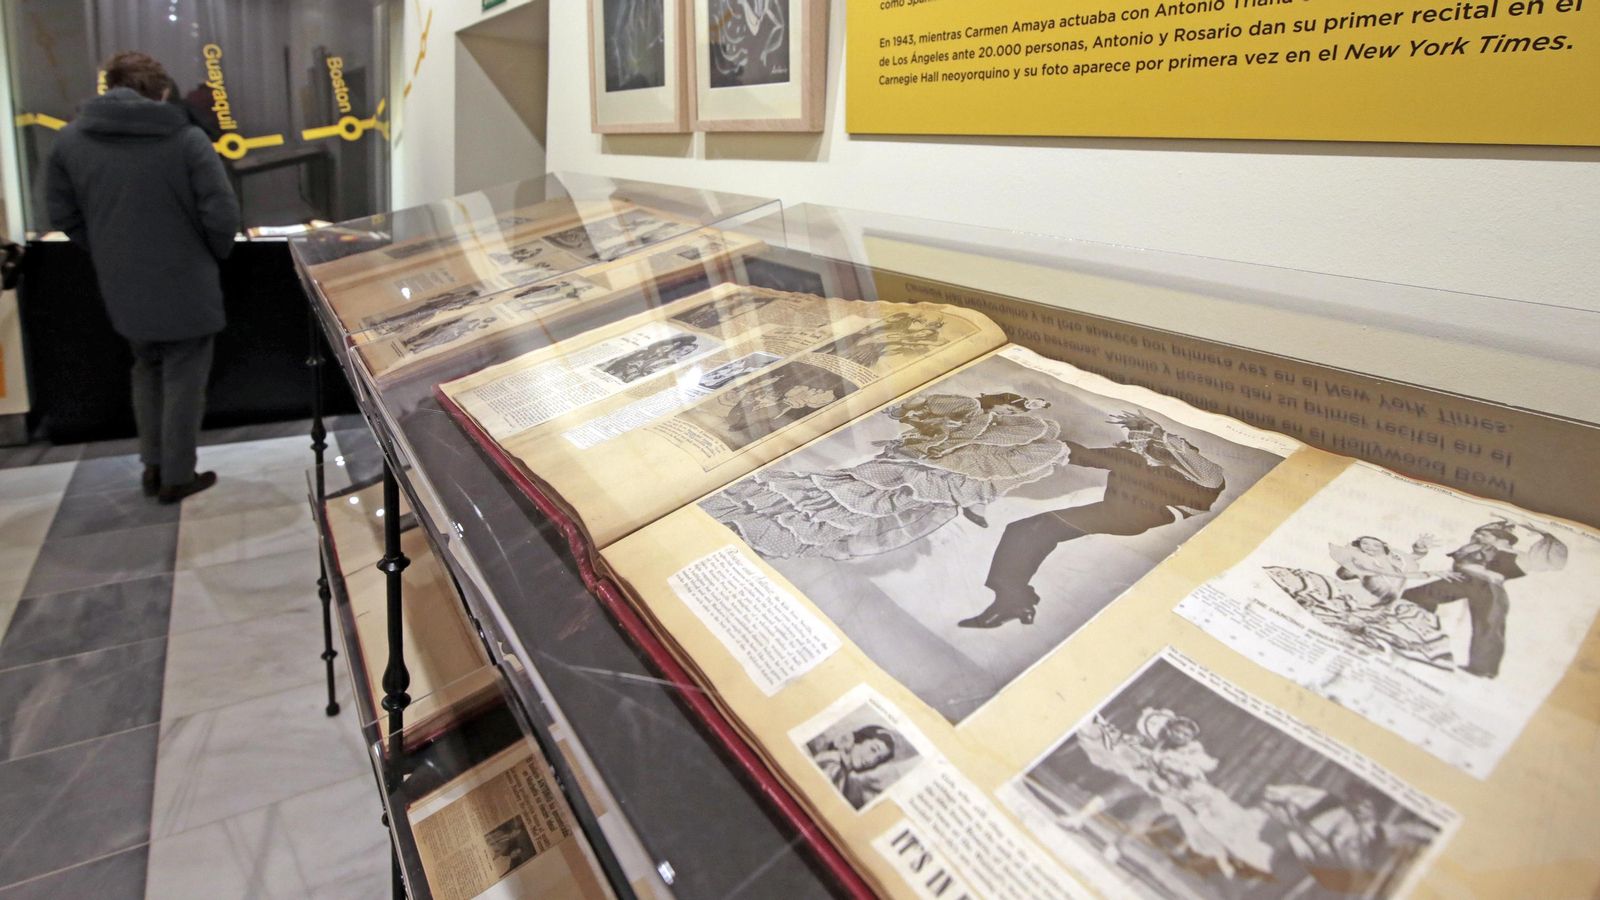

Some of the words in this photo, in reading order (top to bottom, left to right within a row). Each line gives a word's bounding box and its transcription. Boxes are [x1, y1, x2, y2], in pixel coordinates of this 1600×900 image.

[879, 38, 890, 48] En
[892, 35, 916, 47] 1943,
[918, 29, 962, 44] mientras
[965, 24, 1008, 39] Carmen
[1012, 18, 1056, 34] Amaya
[1059, 11, 1116, 27] actuaba
[1121, 8, 1149, 21] con
[1155, 0, 1225, 17] Antonio
[879, 57, 890, 67] de
[892, 55, 908, 66] Los
[911, 50, 949, 65] Ángeles
[952, 49, 976, 61] ante
[978, 43, 1022, 59] 20.000
[1025, 40, 1087, 56] personas,
[1093, 32, 1153, 48] Antonio
[1158, 32, 1168, 46] y
[1174, 23, 1242, 42] Rosario
[1249, 20, 1286, 36] dan
[1293, 19, 1316, 32] su
[1324, 12, 1404, 33] primer
[1412, 0, 1498, 24] recital
[1508, 0, 1544, 16] en
[1556, 0, 1582, 12] el
[326, 56, 352, 113] Boston
[879, 73, 918, 85] Carnegie
[920, 71, 939, 83] Hall
[941, 67, 1010, 82] neoyorquino
[1013, 68, 1021, 79] y
[1024, 67, 1038, 77] su
[1042, 64, 1068, 75] foto
[1073, 61, 1131, 76] aparece
[1136, 59, 1164, 73] por
[1168, 54, 1237, 72] primera
[1245, 52, 1279, 65] vez
[1286, 50, 1310, 63] en
[1318, 44, 1338, 61] el
[1344, 43, 1400, 60] New
[1410, 37, 1470, 57] York
[1480, 34, 1573, 53] Times.
[202, 44, 237, 130] Guayaquil
[891, 829, 933, 873] IT'S
